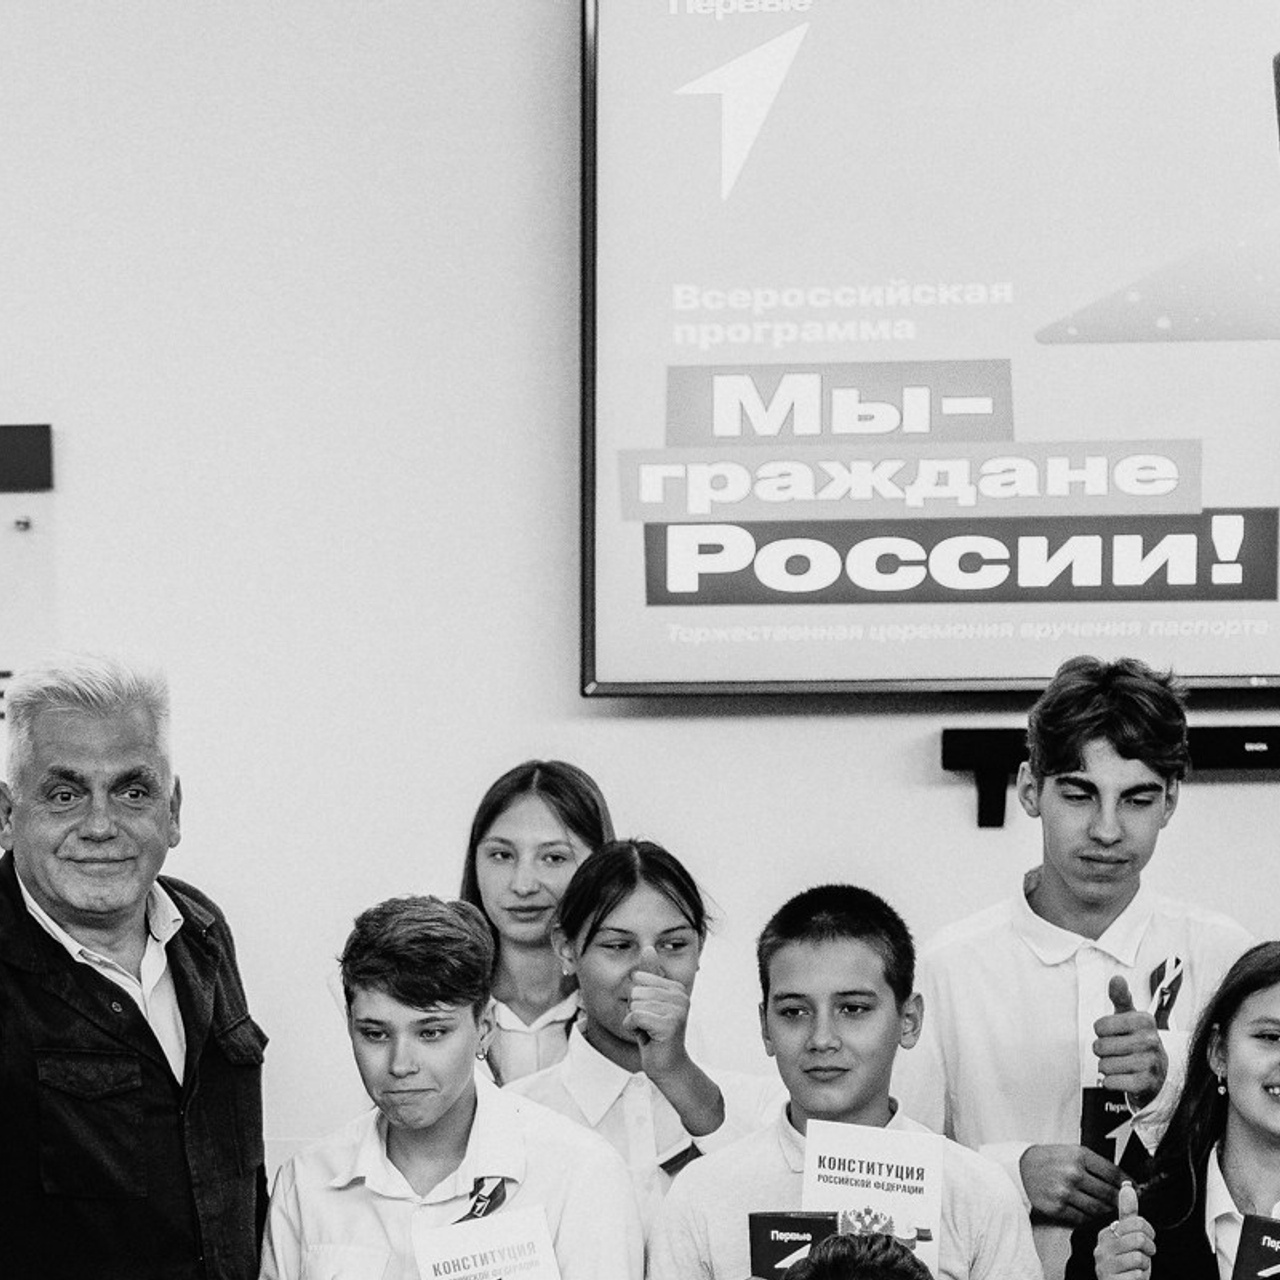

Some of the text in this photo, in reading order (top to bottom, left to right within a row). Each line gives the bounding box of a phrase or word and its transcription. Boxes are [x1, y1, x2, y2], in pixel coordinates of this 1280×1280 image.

[672, 280, 1014, 316] Всероссийская
[673, 319, 916, 350] программа
[637, 453, 1181, 515] граждане
[665, 514, 1245, 594] России!
[1019, 620, 1142, 641] вручения
[1147, 618, 1269, 639] паспорта
[817, 1155, 925, 1182] КОНСТИТУЦИЯ
[817, 1174, 924, 1195] РОССИЙСКОЙ ФЕДЕРАЦИИ
[771, 1230, 813, 1243] Первые
[432, 1241, 536, 1277] КОНСТИТУЦИЯ
